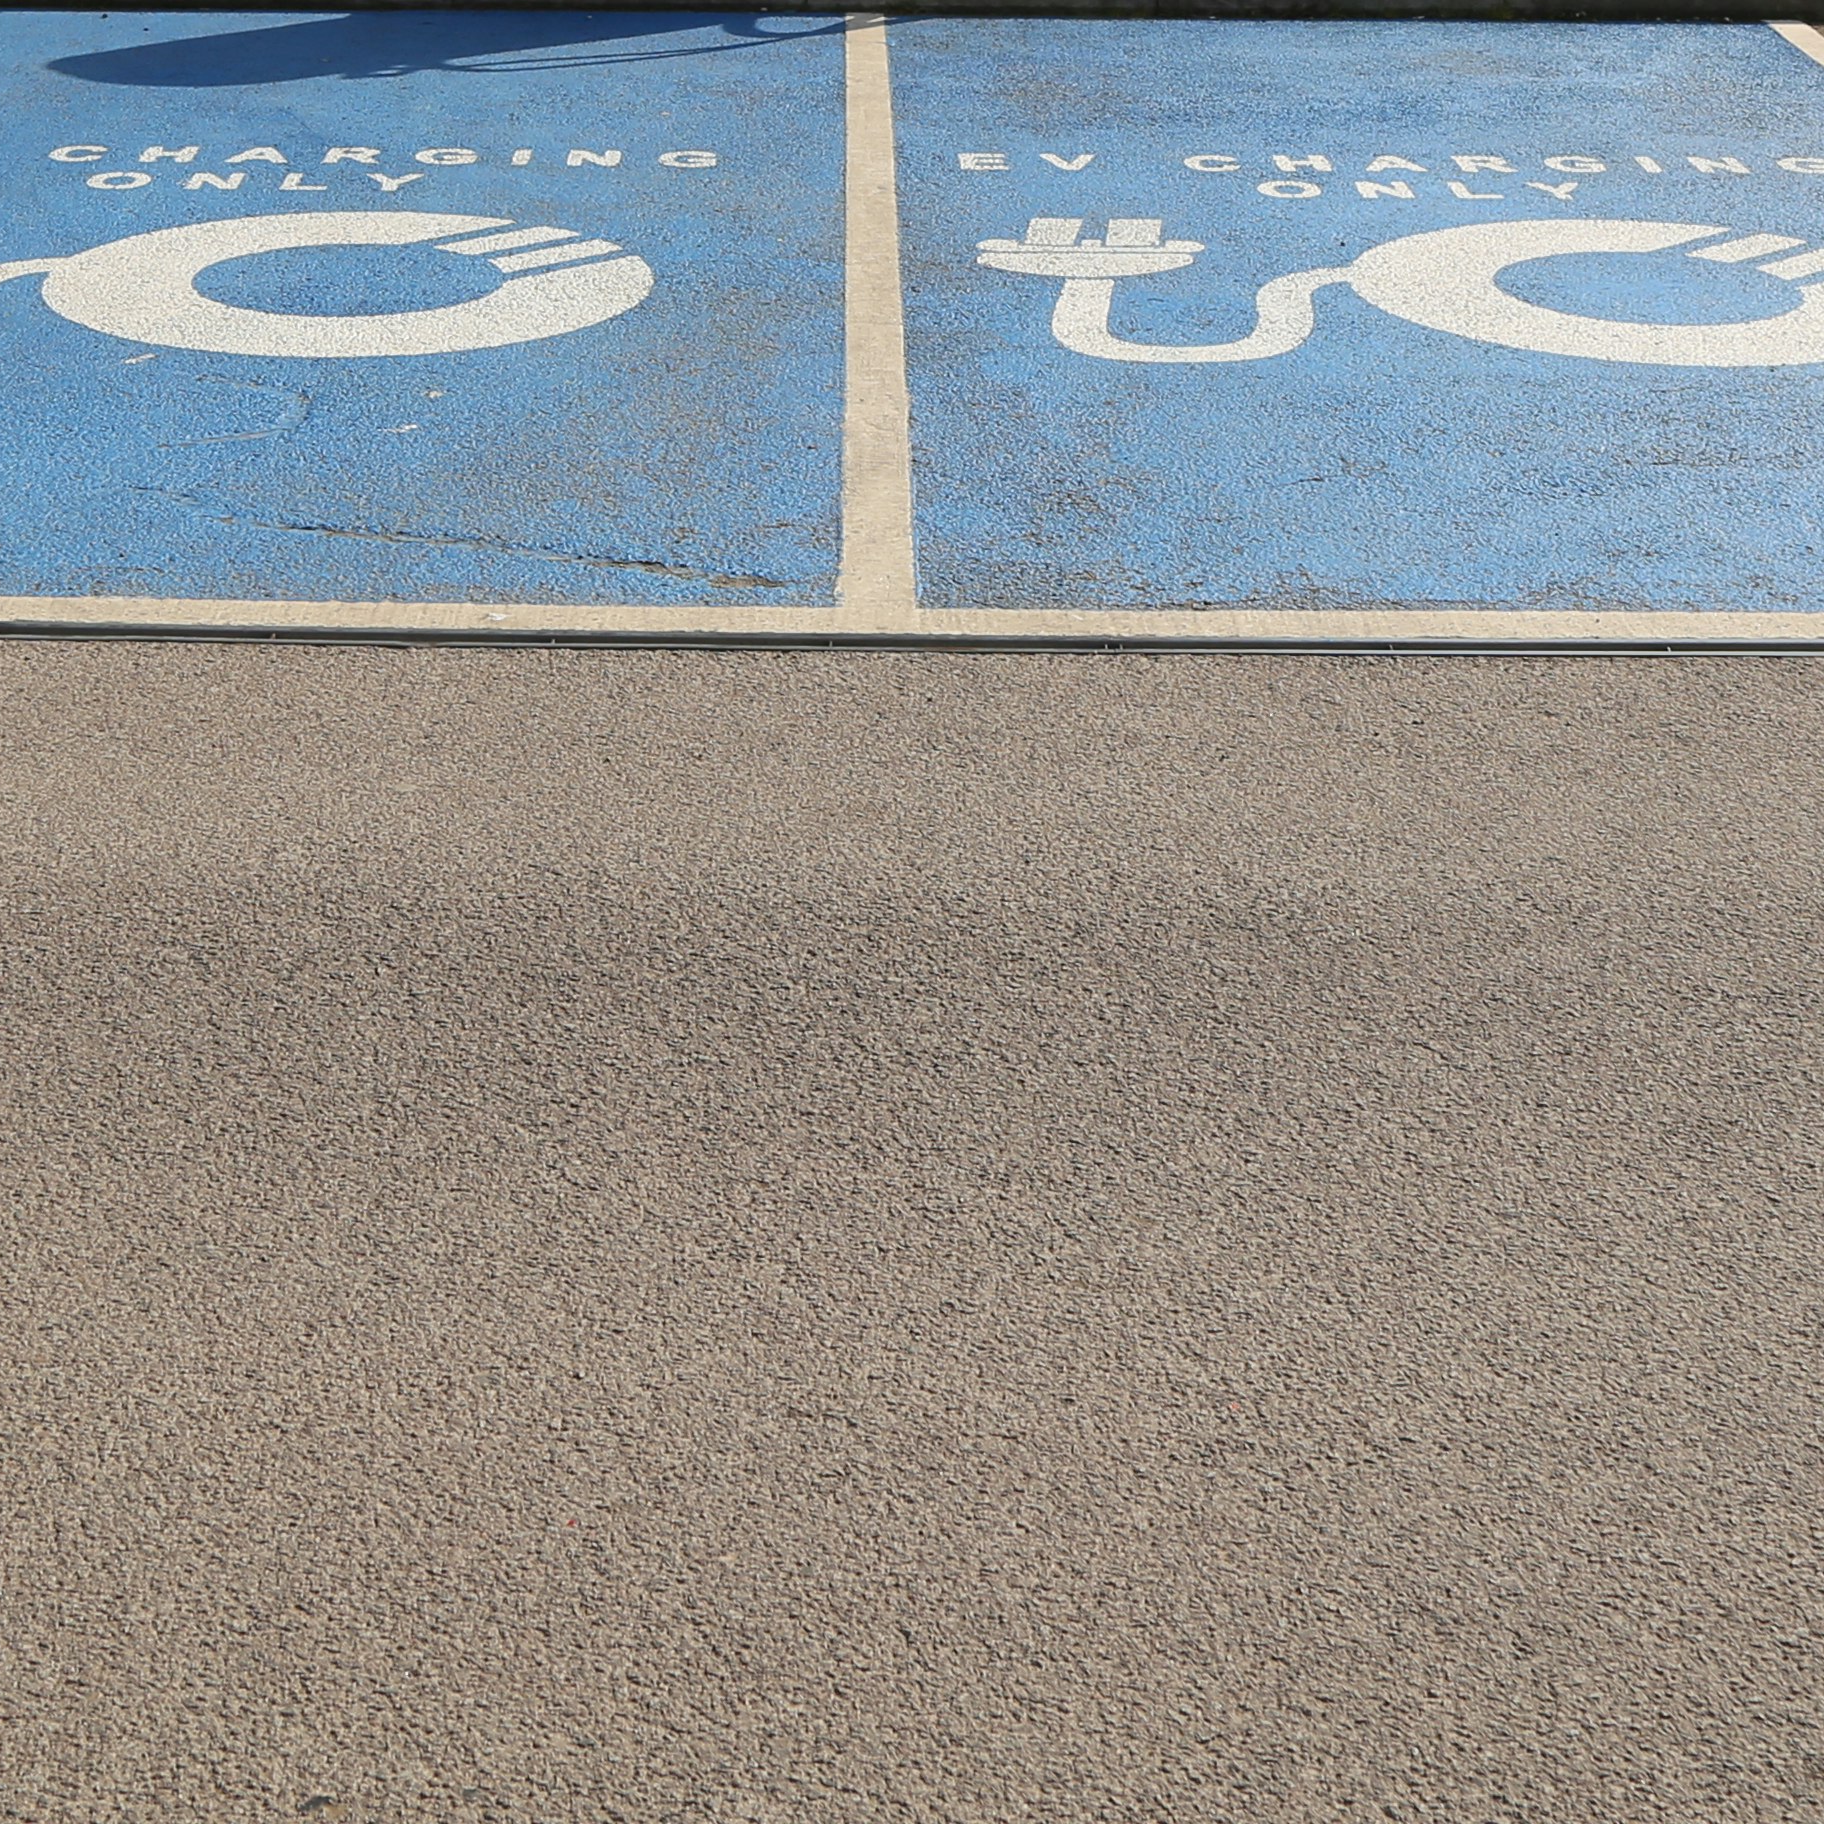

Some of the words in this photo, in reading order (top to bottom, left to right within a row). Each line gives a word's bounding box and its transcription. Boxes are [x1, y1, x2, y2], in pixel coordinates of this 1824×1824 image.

[48, 144, 718, 169] CHARGING
[957, 152, 1097, 172] EV
[85, 171, 427, 192] ONLY
[1256, 179, 1580, 202] ONLY
